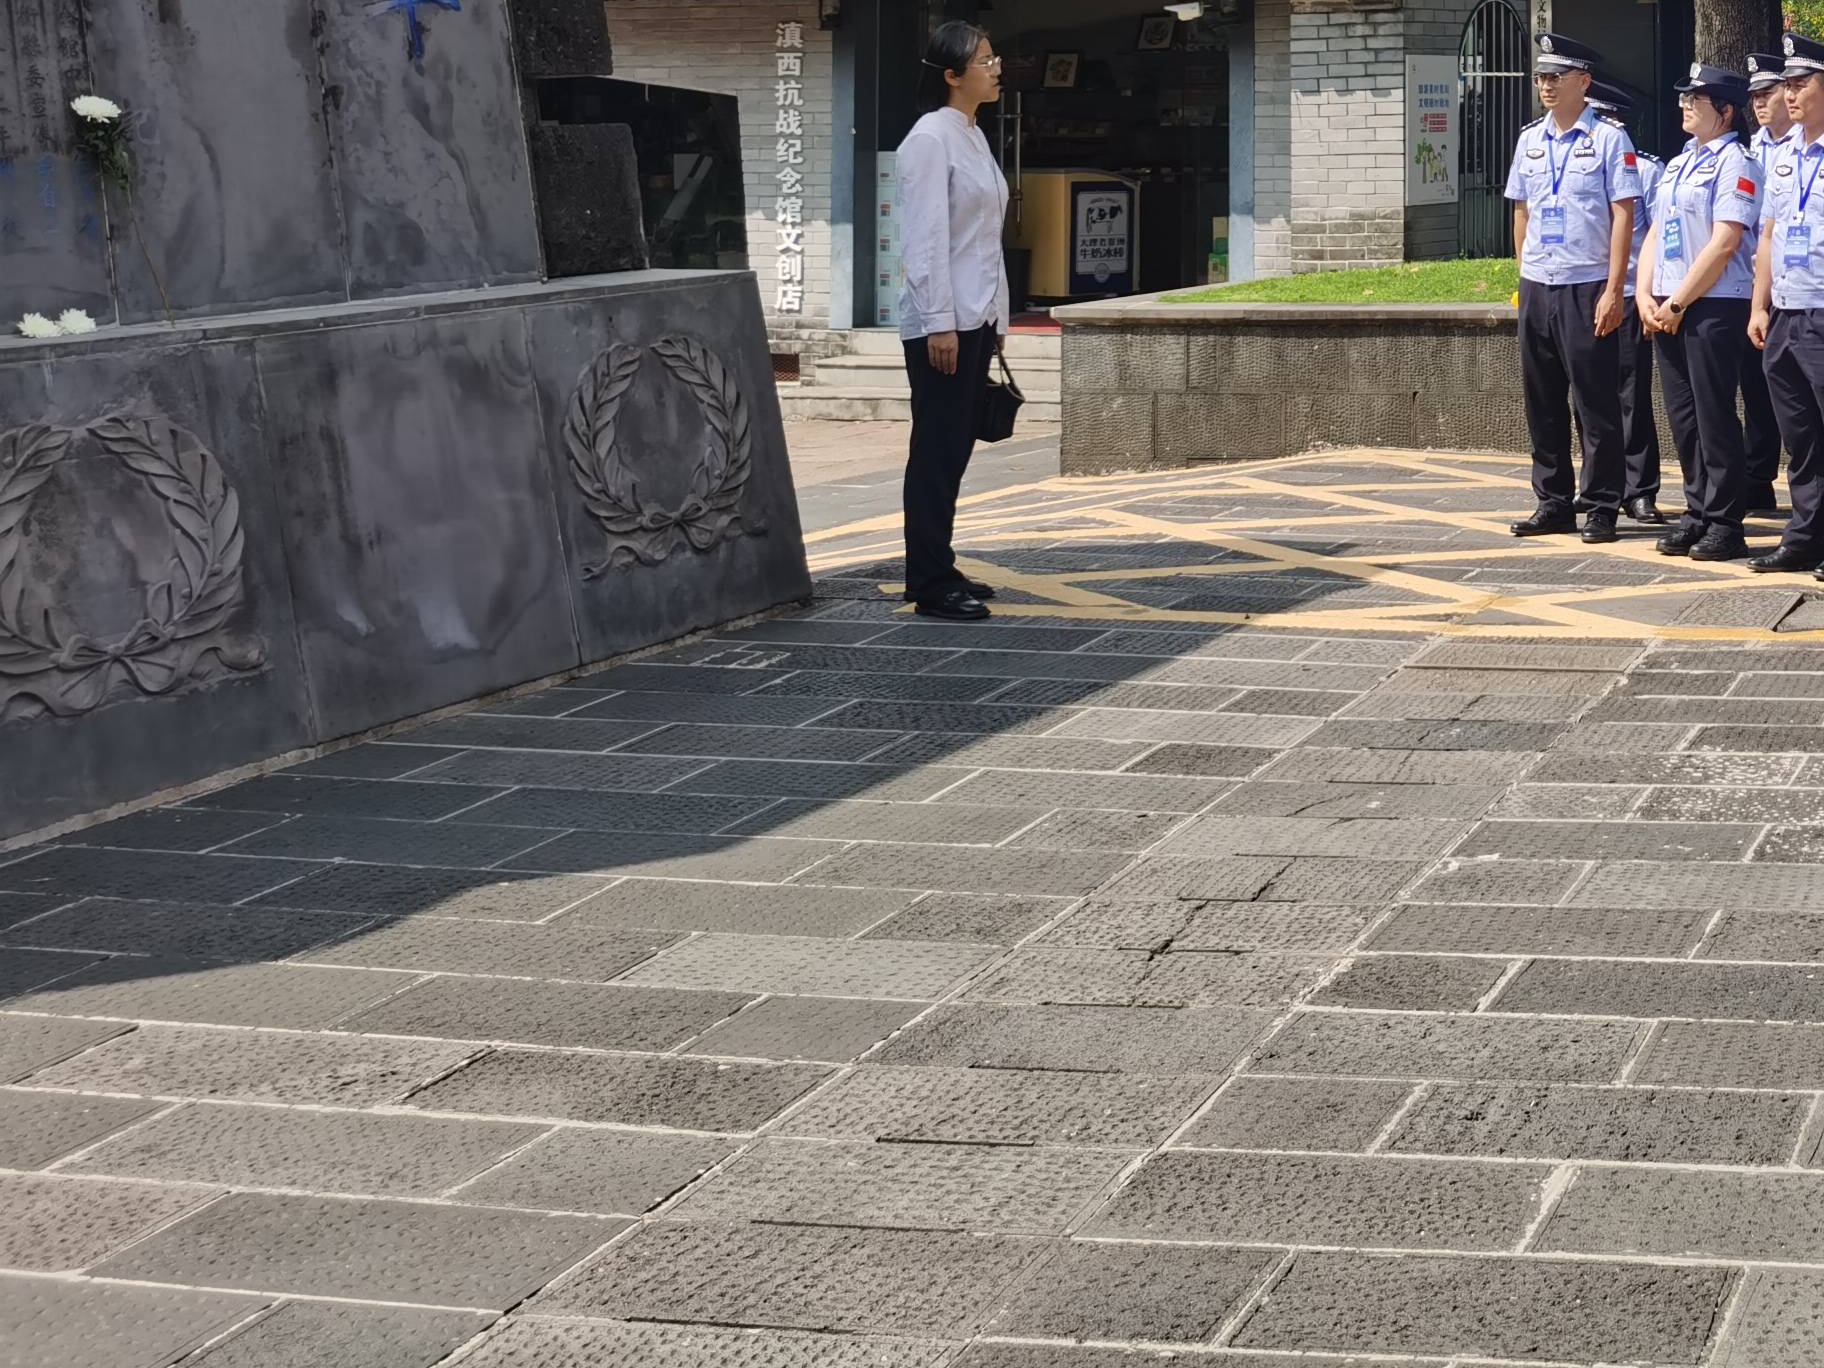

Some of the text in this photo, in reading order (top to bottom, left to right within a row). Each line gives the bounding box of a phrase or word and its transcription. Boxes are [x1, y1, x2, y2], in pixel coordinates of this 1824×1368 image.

[774, 22, 803, 313] 滇西抗战纪念馆文创店
